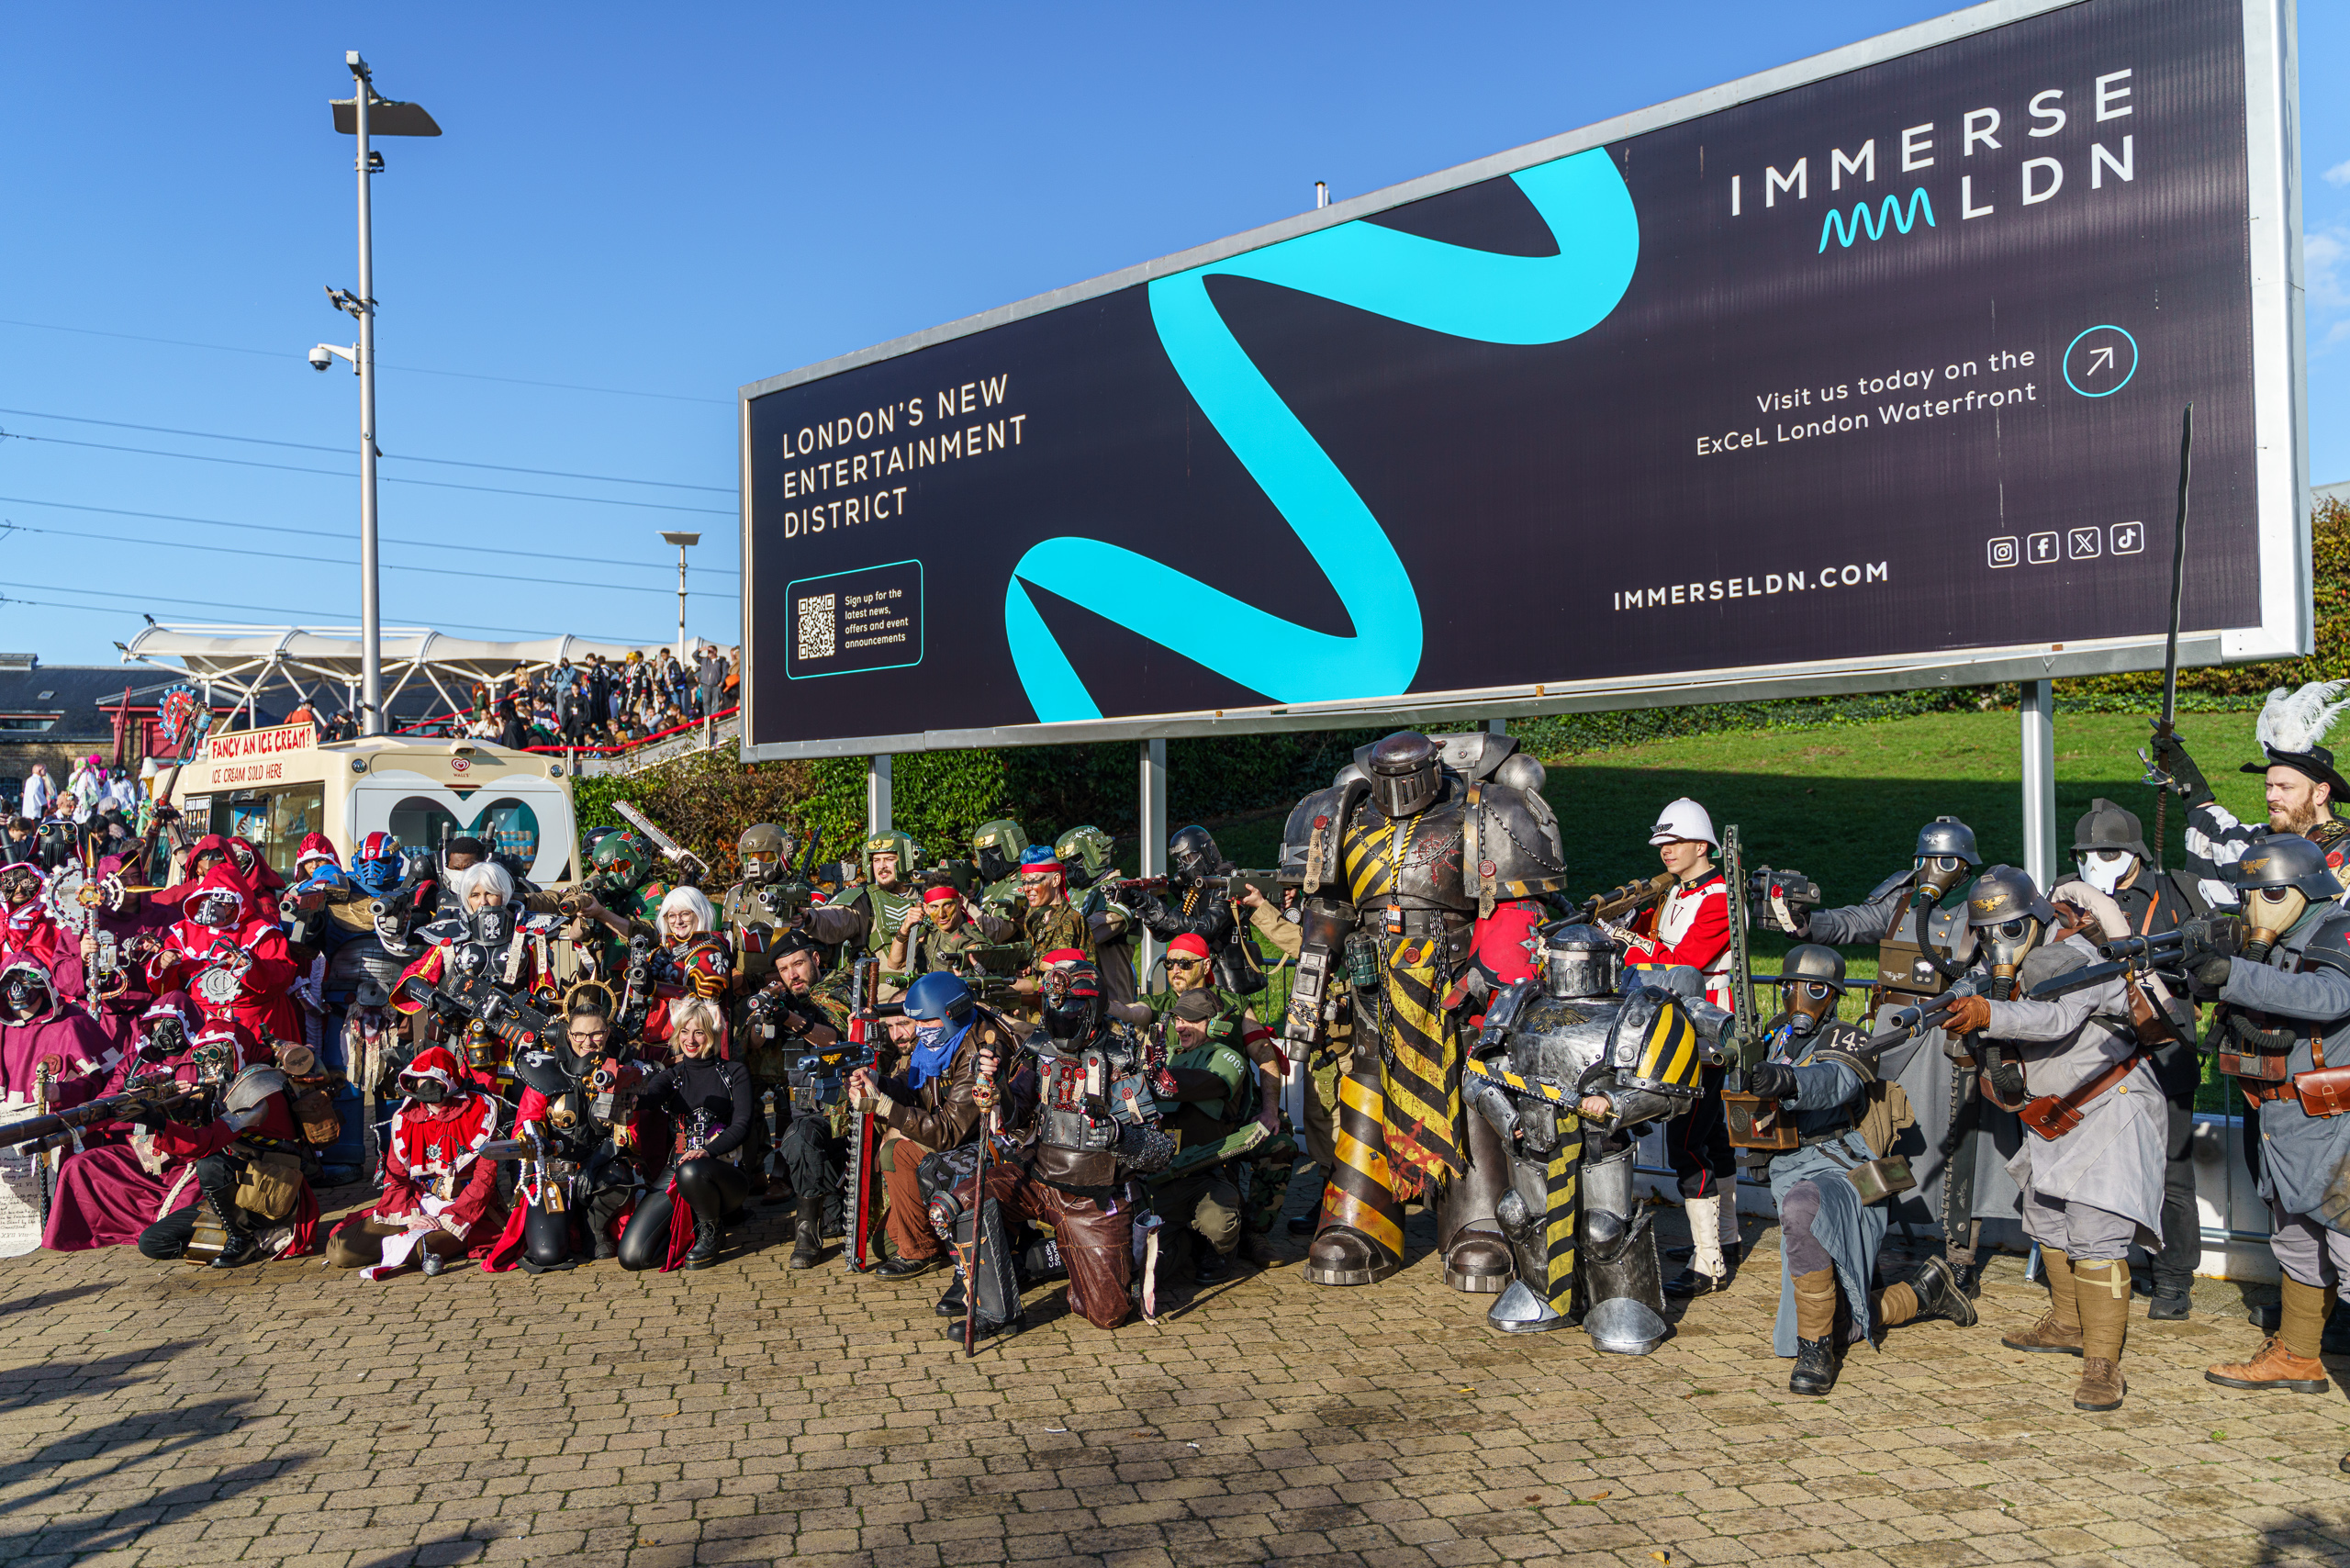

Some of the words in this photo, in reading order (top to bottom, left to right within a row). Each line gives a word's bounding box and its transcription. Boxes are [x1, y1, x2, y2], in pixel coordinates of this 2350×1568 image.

[1731, 68, 2132, 216] IMMERSE
[1962, 134, 2133, 220] LDN
[1756, 387, 1812, 413] Visit
[1820, 382, 1849, 402] us
[1857, 366, 1935, 398] today
[1944, 360, 1978, 381] on
[1988, 349, 2036, 373] the
[783, 398, 923, 459] LONDON'S
[938, 374, 1008, 419] NEW
[1696, 427, 1768, 455] ExCeL
[1777, 411, 1870, 442] London
[1878, 381, 2037, 424] Waterfront
[784, 414, 1026, 498] ENTERTAINMENT
[785, 487, 908, 538] DISTRICT
[845, 594, 862, 607] Sign
[864, 595, 874, 606] up
[875, 590, 888, 601] for
[889, 588, 902, 599] the
[1614, 561, 1889, 611] IMMERSELDN.COM
[845, 608, 867, 620] latest
[869, 606, 891, 617] news,
[845, 622, 867, 634] offers
[869, 620, 885, 631] and
[886, 617, 909, 629] event
[845, 633, 907, 649] announcements
[212, 737, 241, 759] FANCY
[243, 734, 256, 756] AN
[258, 732, 272, 754] ICE
[274, 727, 311, 752] CREAM?
[212, 768, 221, 784] ICE
[223, 767, 246, 783] CREAM
[248, 765, 263, 781] SOLD
[265, 763, 283, 779] HERE
[1222, 1051, 1245, 1075] 4002
